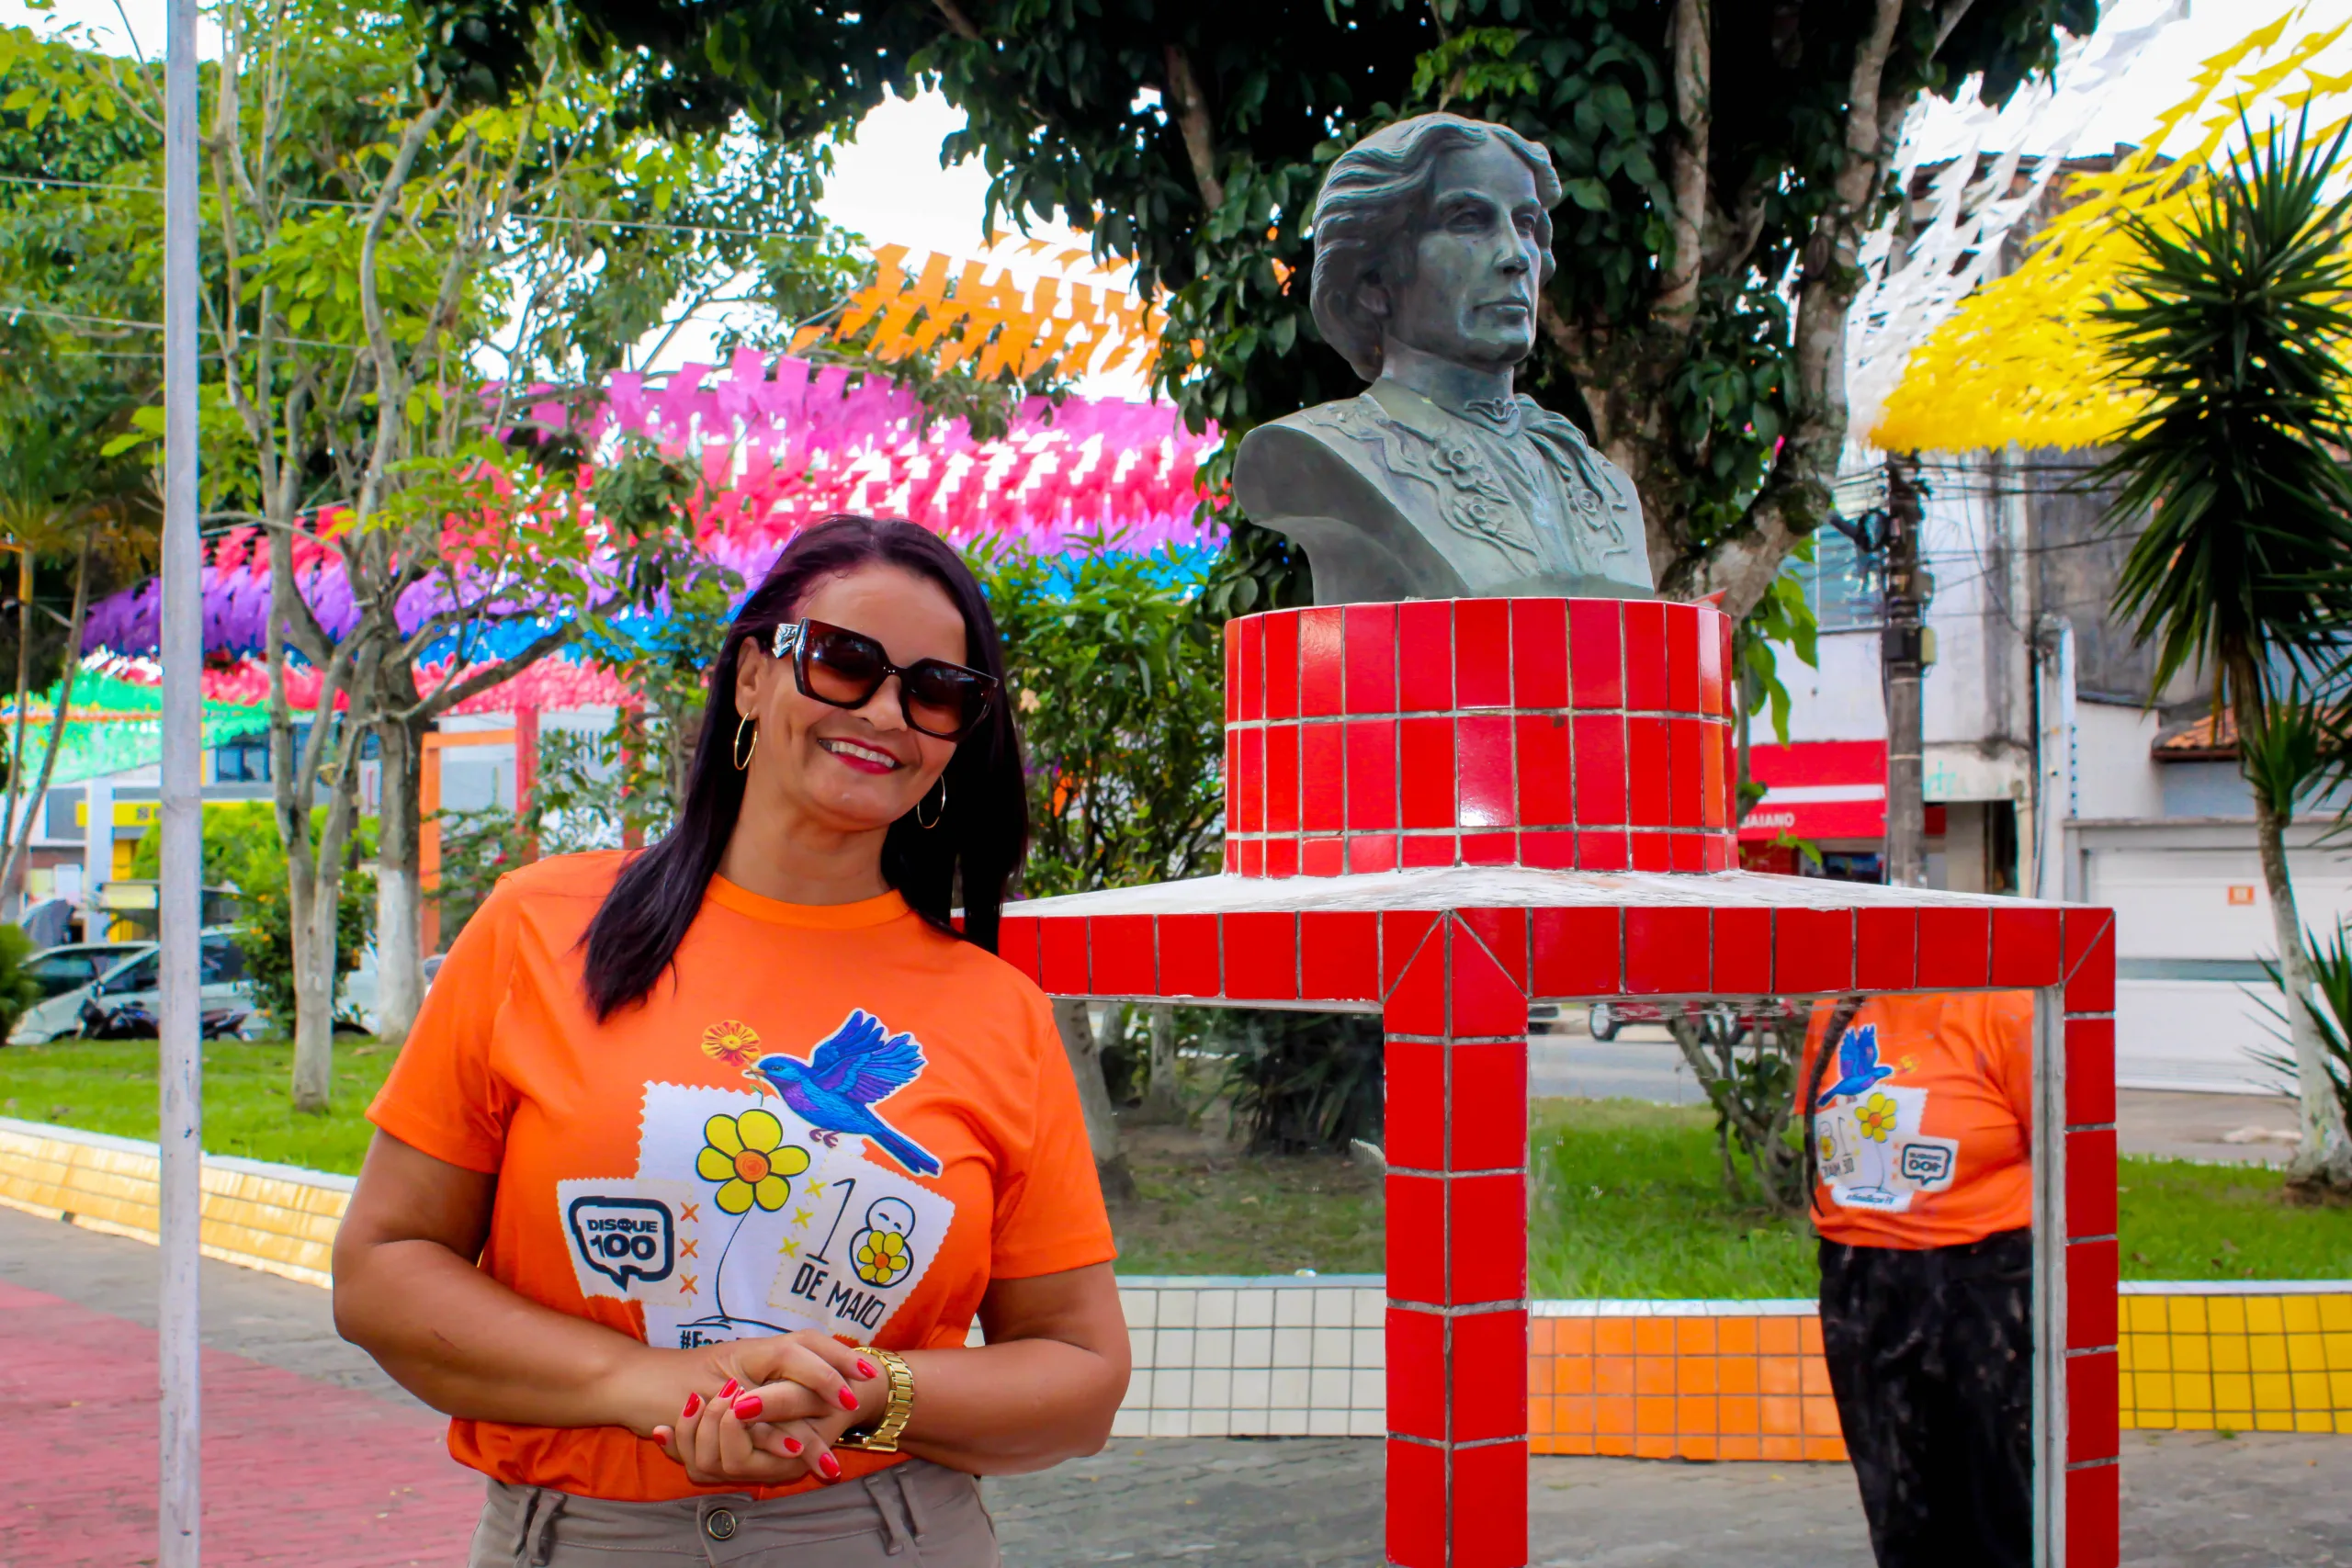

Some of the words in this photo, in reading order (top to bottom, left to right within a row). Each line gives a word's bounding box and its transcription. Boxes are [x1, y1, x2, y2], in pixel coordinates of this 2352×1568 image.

[586, 1218, 659, 1234] DISQUE
[589, 1233, 657, 1261] 100
[806, 1178, 916, 1289] 18
[790, 1262, 829, 1302] DE
[825, 1280, 887, 1330] MAIO
